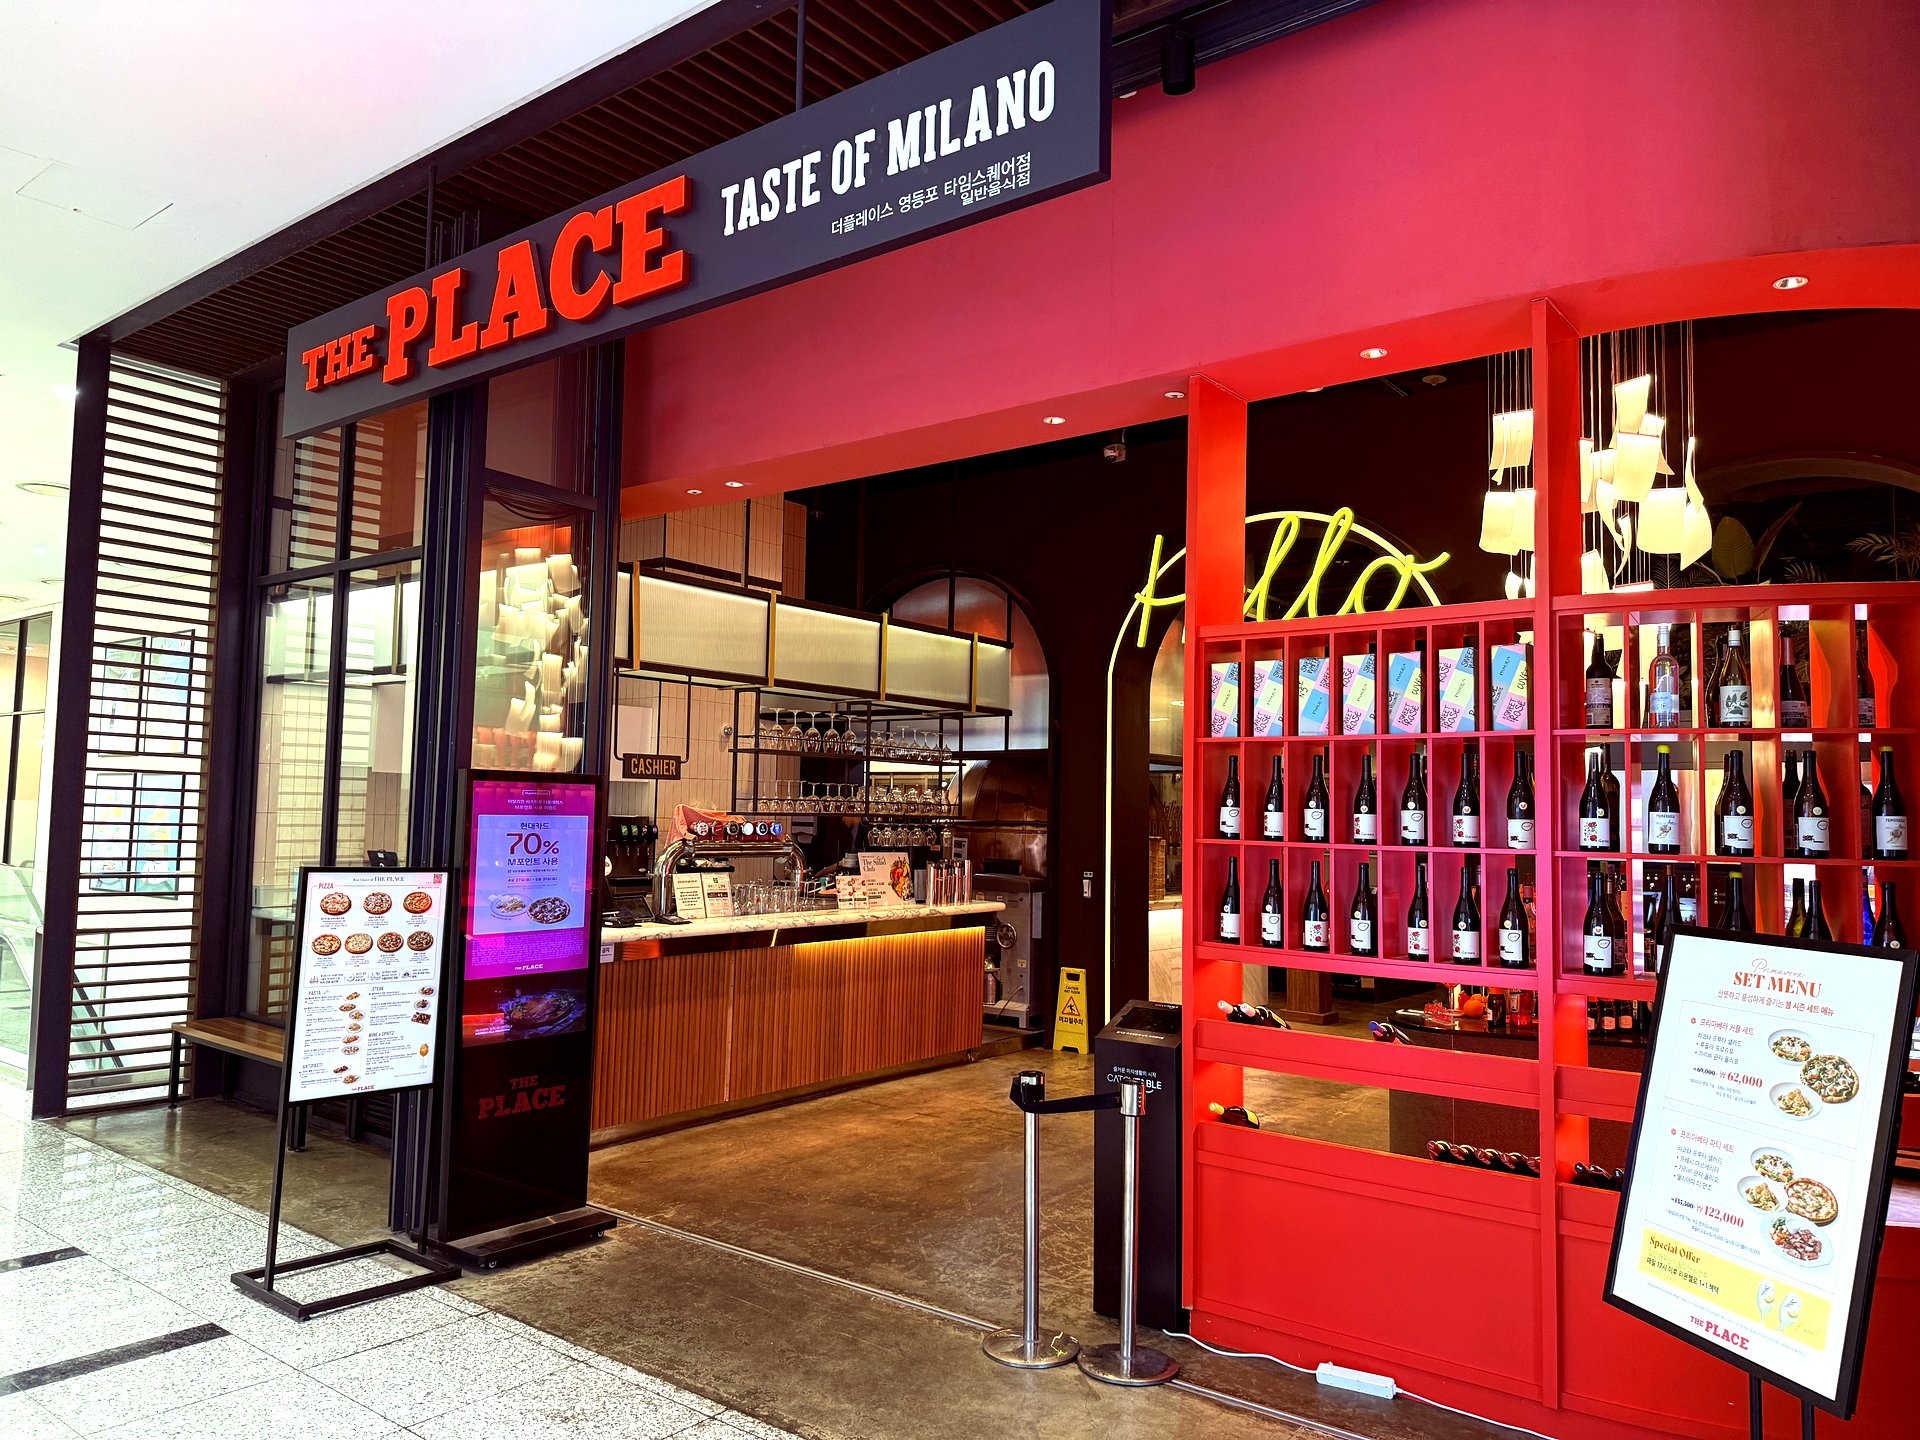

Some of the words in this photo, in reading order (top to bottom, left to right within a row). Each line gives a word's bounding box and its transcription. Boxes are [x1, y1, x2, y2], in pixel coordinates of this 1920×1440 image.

[721, 149, 822, 237] TASTE
[831, 127, 871, 195] OF
[886, 60, 1056, 176] MILANO
[831, 202, 893, 235] 더플레이스
[898, 185, 938, 213] 영등포
[944, 151, 1031, 196] 타임스퀘어점
[961, 171, 1031, 207] 일반음식점
[302, 324, 381, 392] THE
[382, 174, 694, 384] PLACE
[631, 758, 676, 776] CASHIER
[520, 822, 550, 830] 현대카드
[506, 833, 560, 855] 70%
[507, 858, 542, 867] M포인트
[543, 857, 559, 866] 사용
[318, 882, 334, 890] PIZZA
[1751, 958, 1806, 978] Primavera
[1733, 970, 1765, 989] SET
[1767, 976, 1822, 998] MENU
[1717, 990, 1741, 1000] 산뜻하고
[1741, 993, 1765, 1004] 풍성하게
[1765, 997, 1783, 1009] 즐기는
[1784, 1000, 1791, 1009] 봄
[1792, 1002, 1806, 1012] 시즌
[1806, 1004, 1819, 1014] 세트
[1700, 1018, 1728, 1030] 프리마베라
[1729, 1024, 1741, 1034] 커플
[1742, 1026, 1754, 1036] 세트
[1113, 1066, 1126, 1074] 즐거운
[509, 1075, 539, 1090] THE
[478, 1085, 566, 1120] PLACE
[1680, 1130, 1709, 1146] 프리마베라
[1709, 1139, 1722, 1149] 파티
[1722, 1144, 1735, 1153] 세트
[1649, 1235, 1678, 1256] Special
[1679, 1248, 1701, 1264] Offer
[1646, 1256, 1656, 1267] 매일
[1657, 1260, 1668, 1272] 17시
[1668, 1264, 1678, 1276] 이후
[1690, 1315, 1705, 1327] THE
[1704, 1320, 1750, 1351] PLACE
